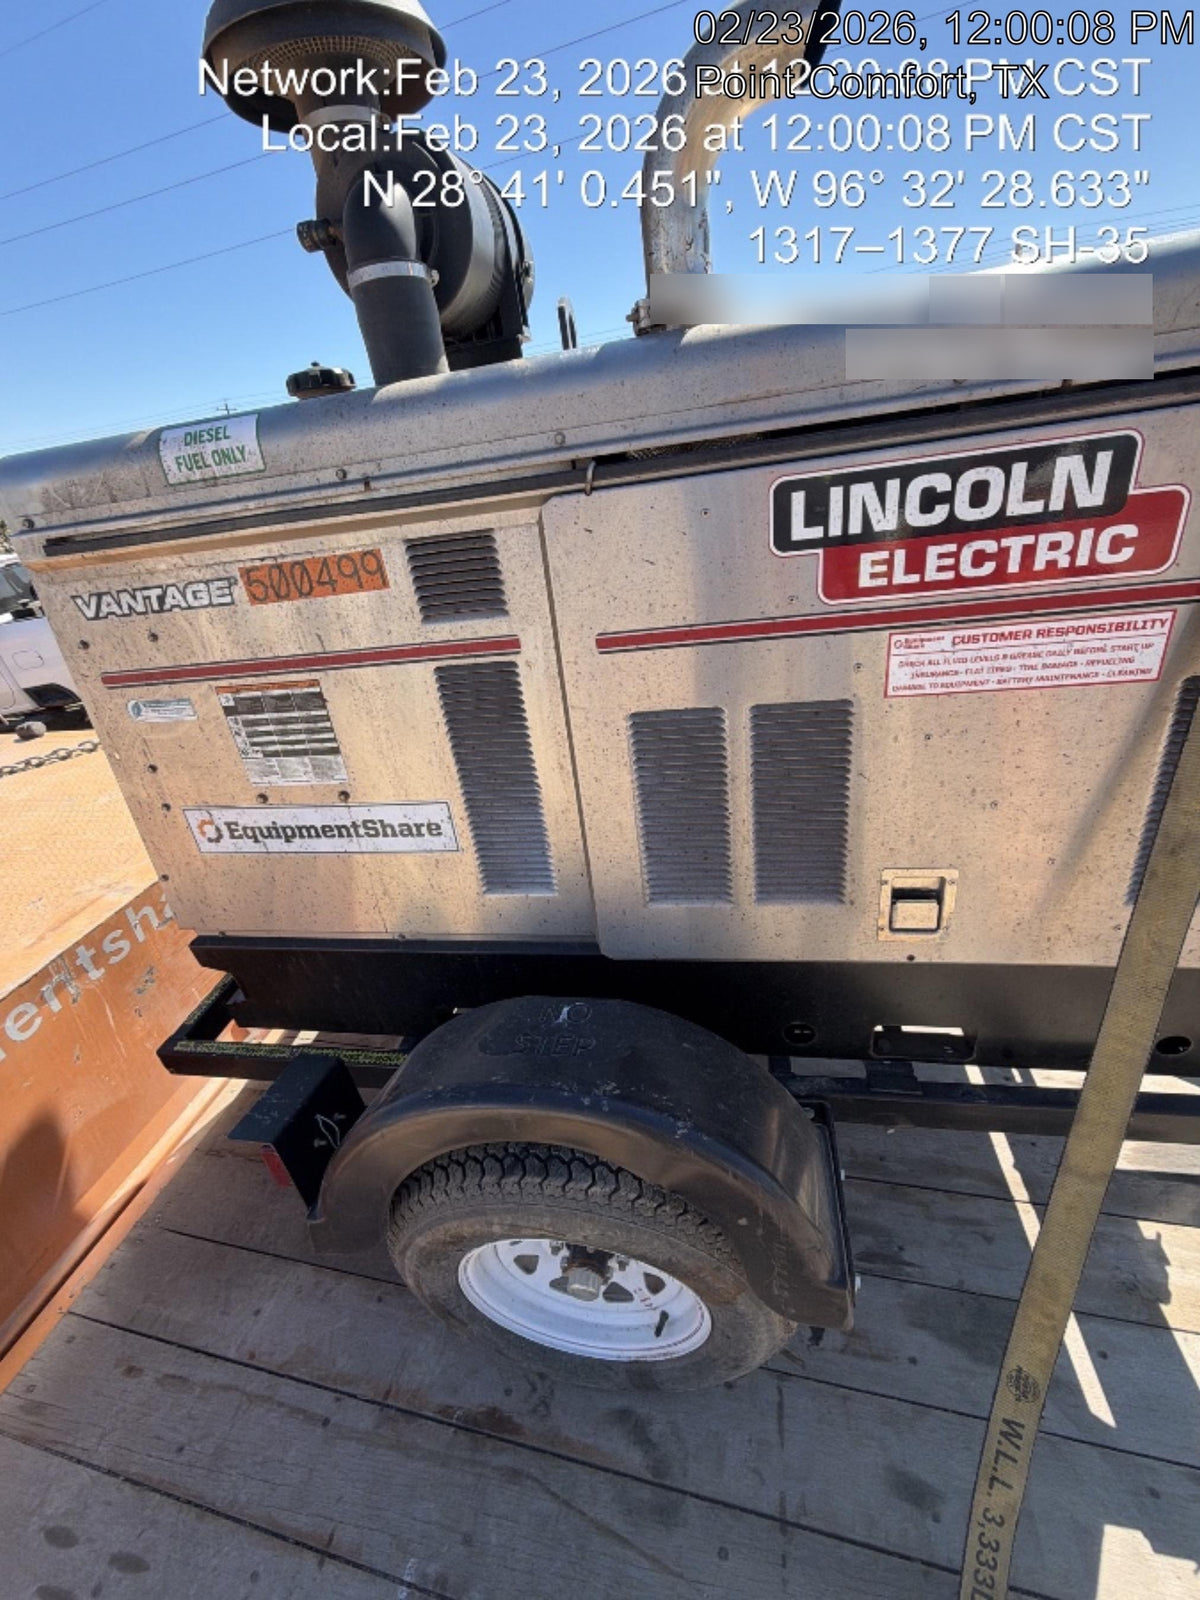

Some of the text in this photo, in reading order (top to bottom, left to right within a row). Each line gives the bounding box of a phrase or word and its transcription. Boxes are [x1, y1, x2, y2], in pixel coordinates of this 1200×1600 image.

[184, 424, 231, 446] DIESEL
[174, 444, 247, 473] FUEL ONLY
[790, 450, 1114, 541] LINCOLN
[246, 549, 387, 603] 500499
[858, 524, 1139, 588] ELECTRIC
[71, 575, 237, 621] VANTAGE
[952, 618, 1169, 646] CUSTOMER RESPONSIBILITY
[223, 818, 444, 844] EquipmentShare
[986, 1416, 1026, 1498] W.L.L.
